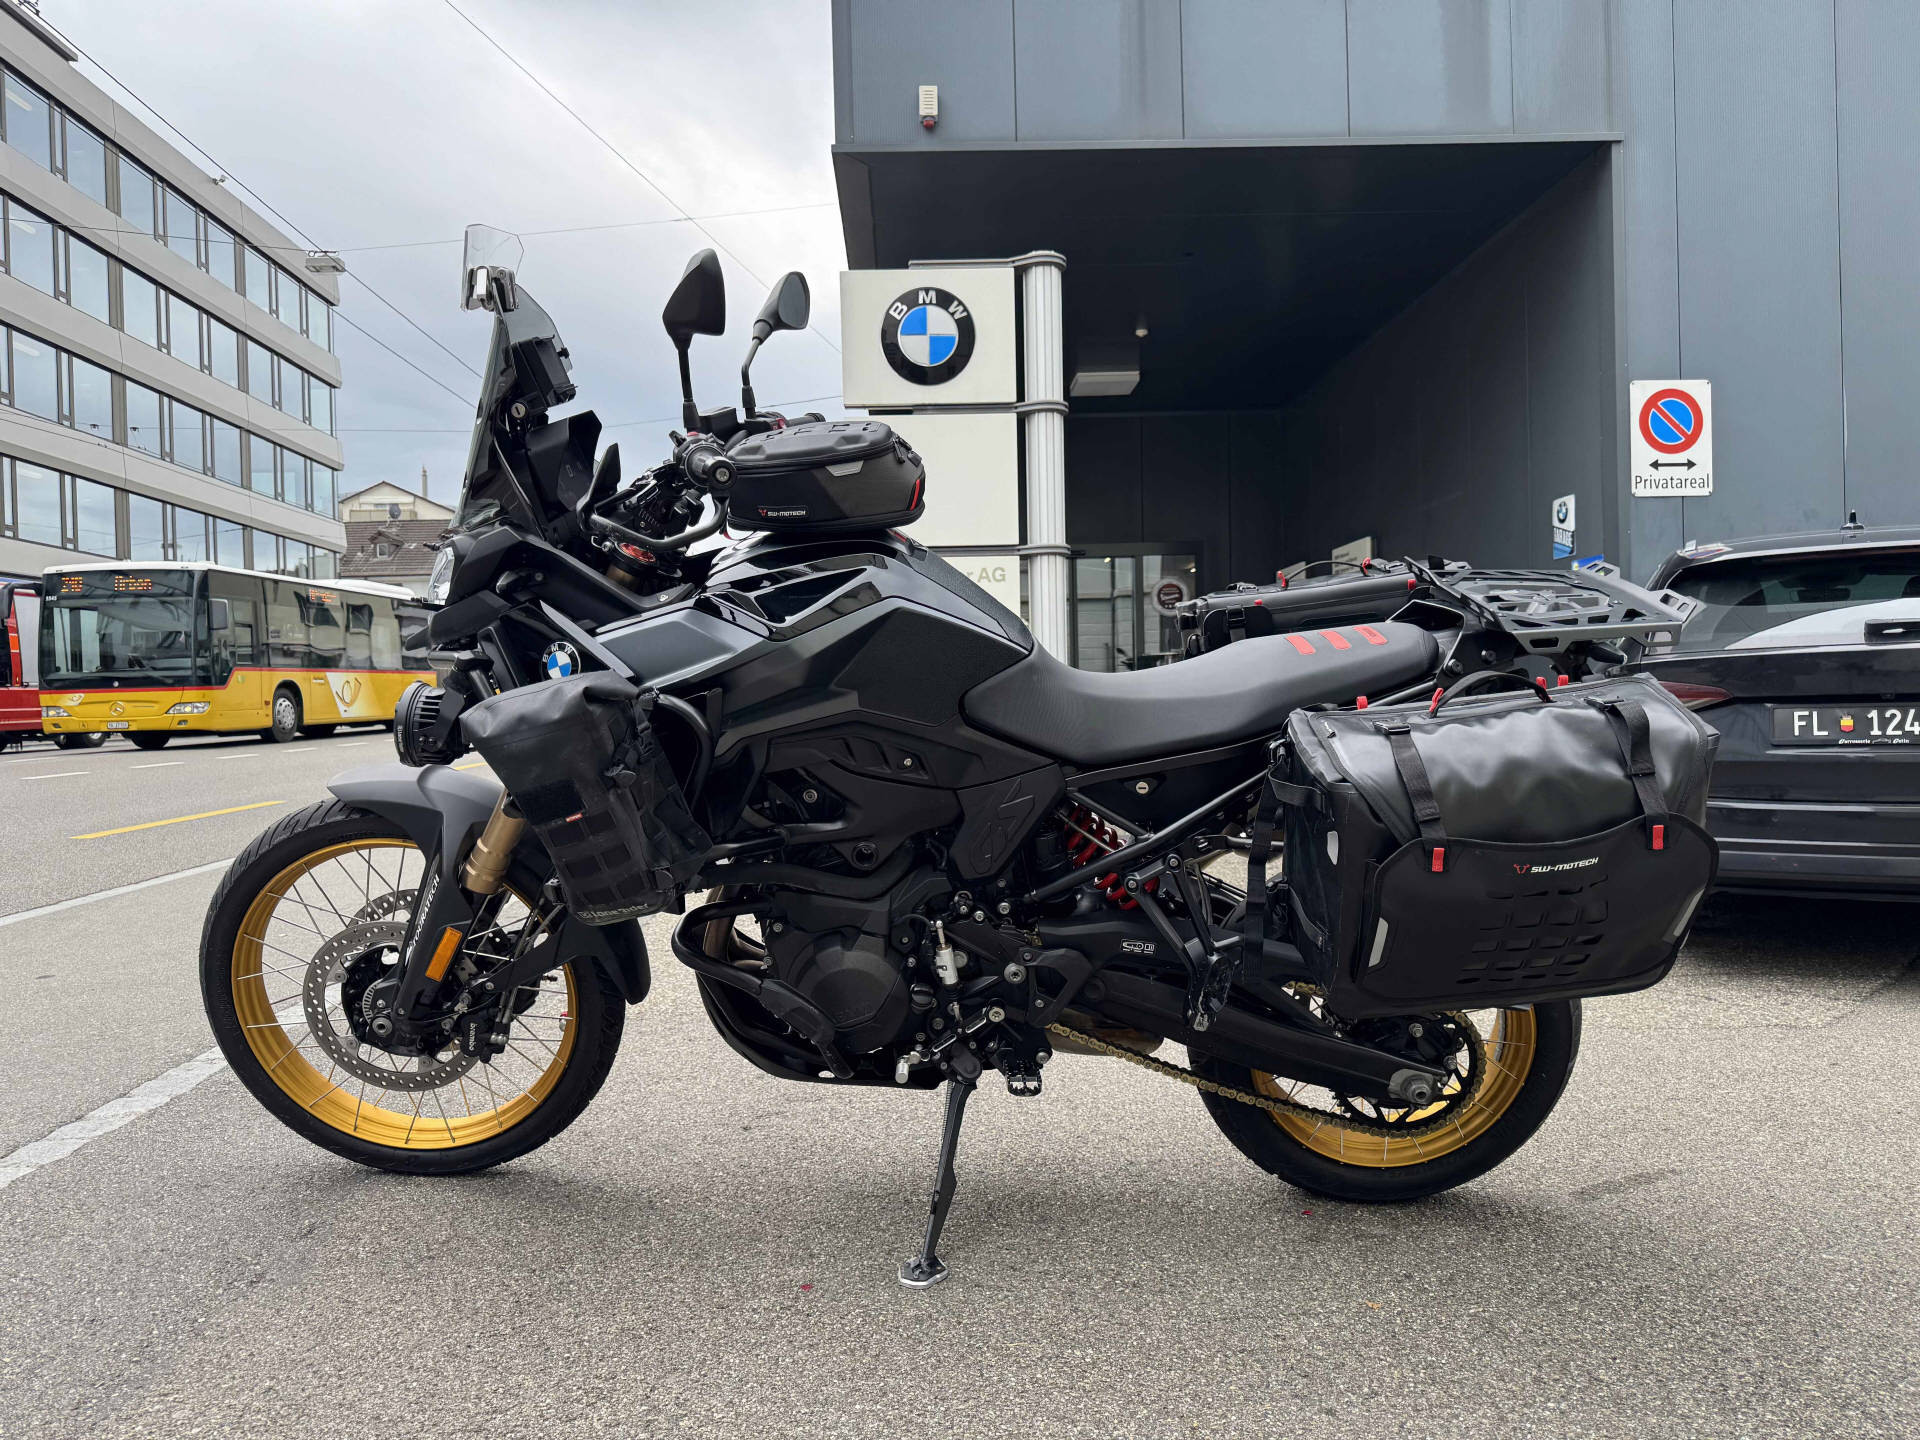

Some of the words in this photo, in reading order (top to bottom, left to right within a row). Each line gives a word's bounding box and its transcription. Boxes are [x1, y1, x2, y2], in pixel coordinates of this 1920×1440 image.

[888, 289, 968, 321] BMW
[1634, 473, 1710, 489] Privatareal
[977, 567, 1007, 583] AG
[542, 643, 575, 663] BMW
[1793, 711, 1829, 736] FL
[1866, 709, 1920, 736] 124
[1530, 857, 1599, 873] SW-MOTECH
[412, 873, 440, 947] TOURATECH
[469, 1022, 477, 1051] brembo
